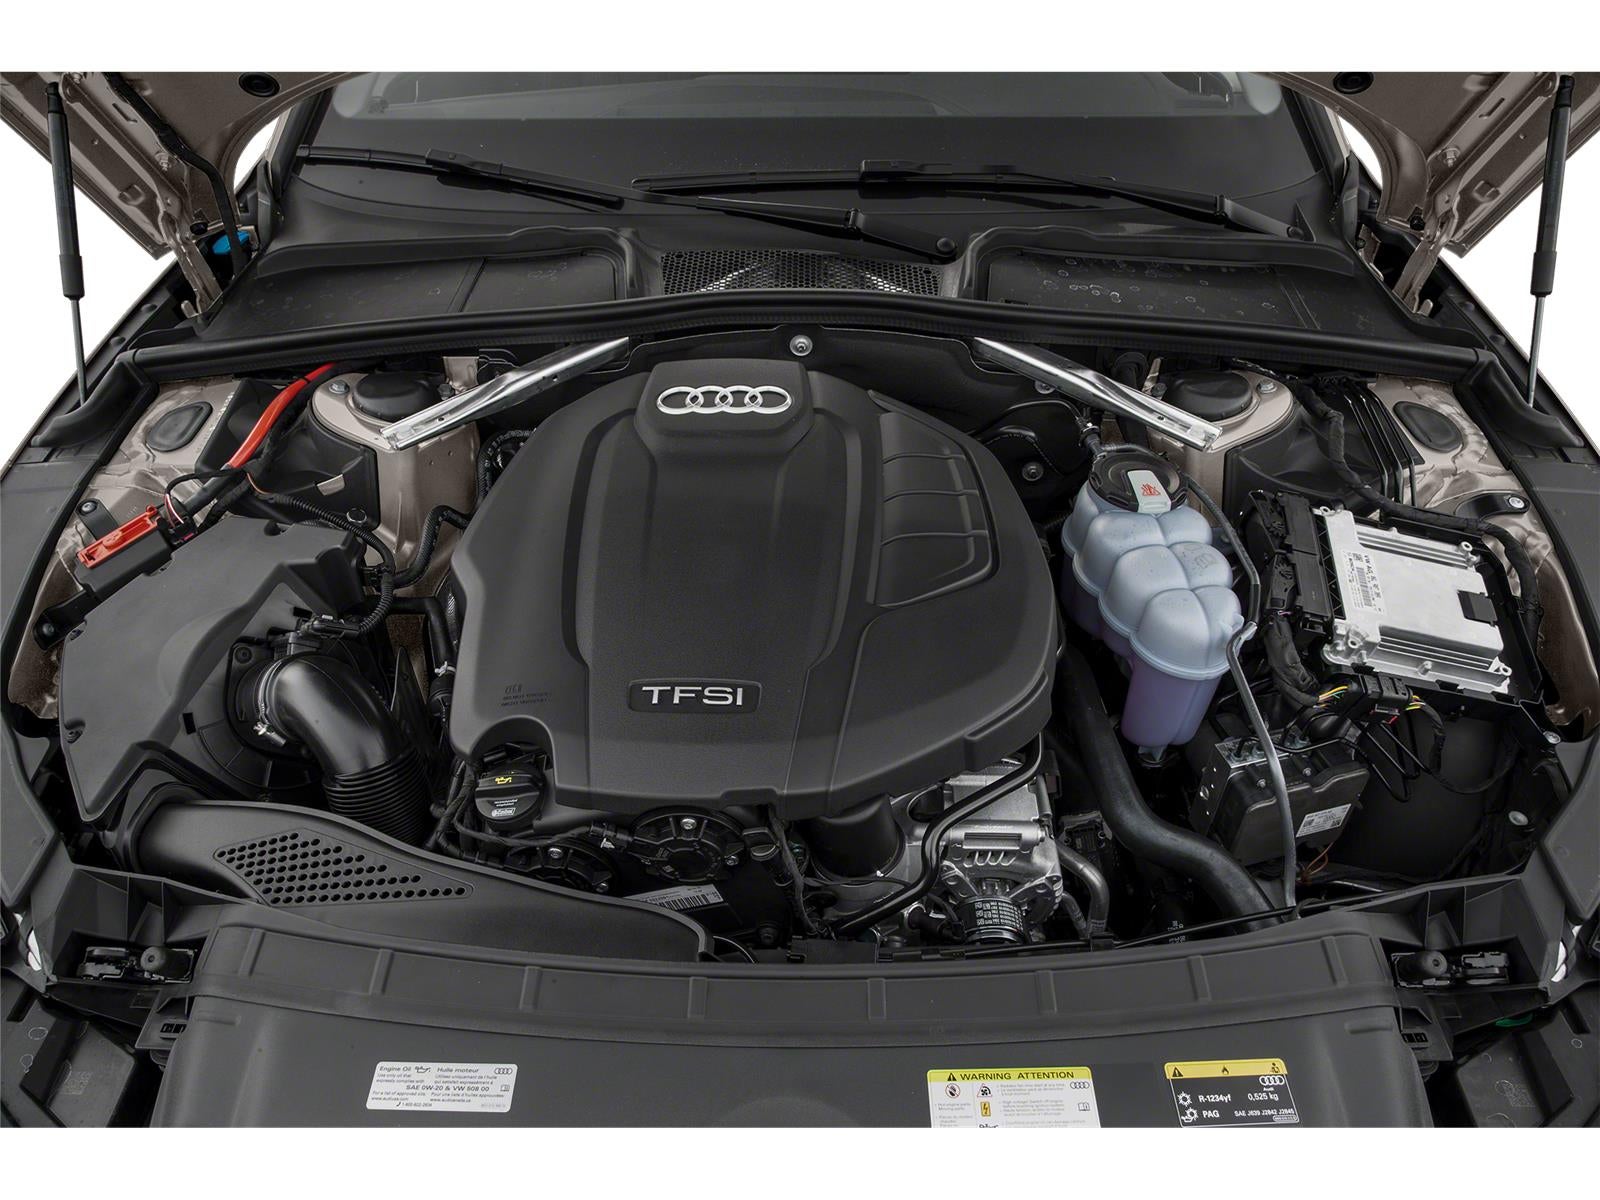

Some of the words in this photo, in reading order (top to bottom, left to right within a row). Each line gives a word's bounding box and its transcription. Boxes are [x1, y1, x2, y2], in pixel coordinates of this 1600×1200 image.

[641, 685, 744, 706] TFSI
[959, 1072, 1012, 1080] WARNING
[1017, 1071, 1075, 1079] ATTENTION
[1198, 1093, 1232, 1103] R-1234yf
[1247, 1092, 1269, 1102] 0,525
[1268, 1092, 1279, 1102] kg
[1202, 1110, 1220, 1119] PAG
